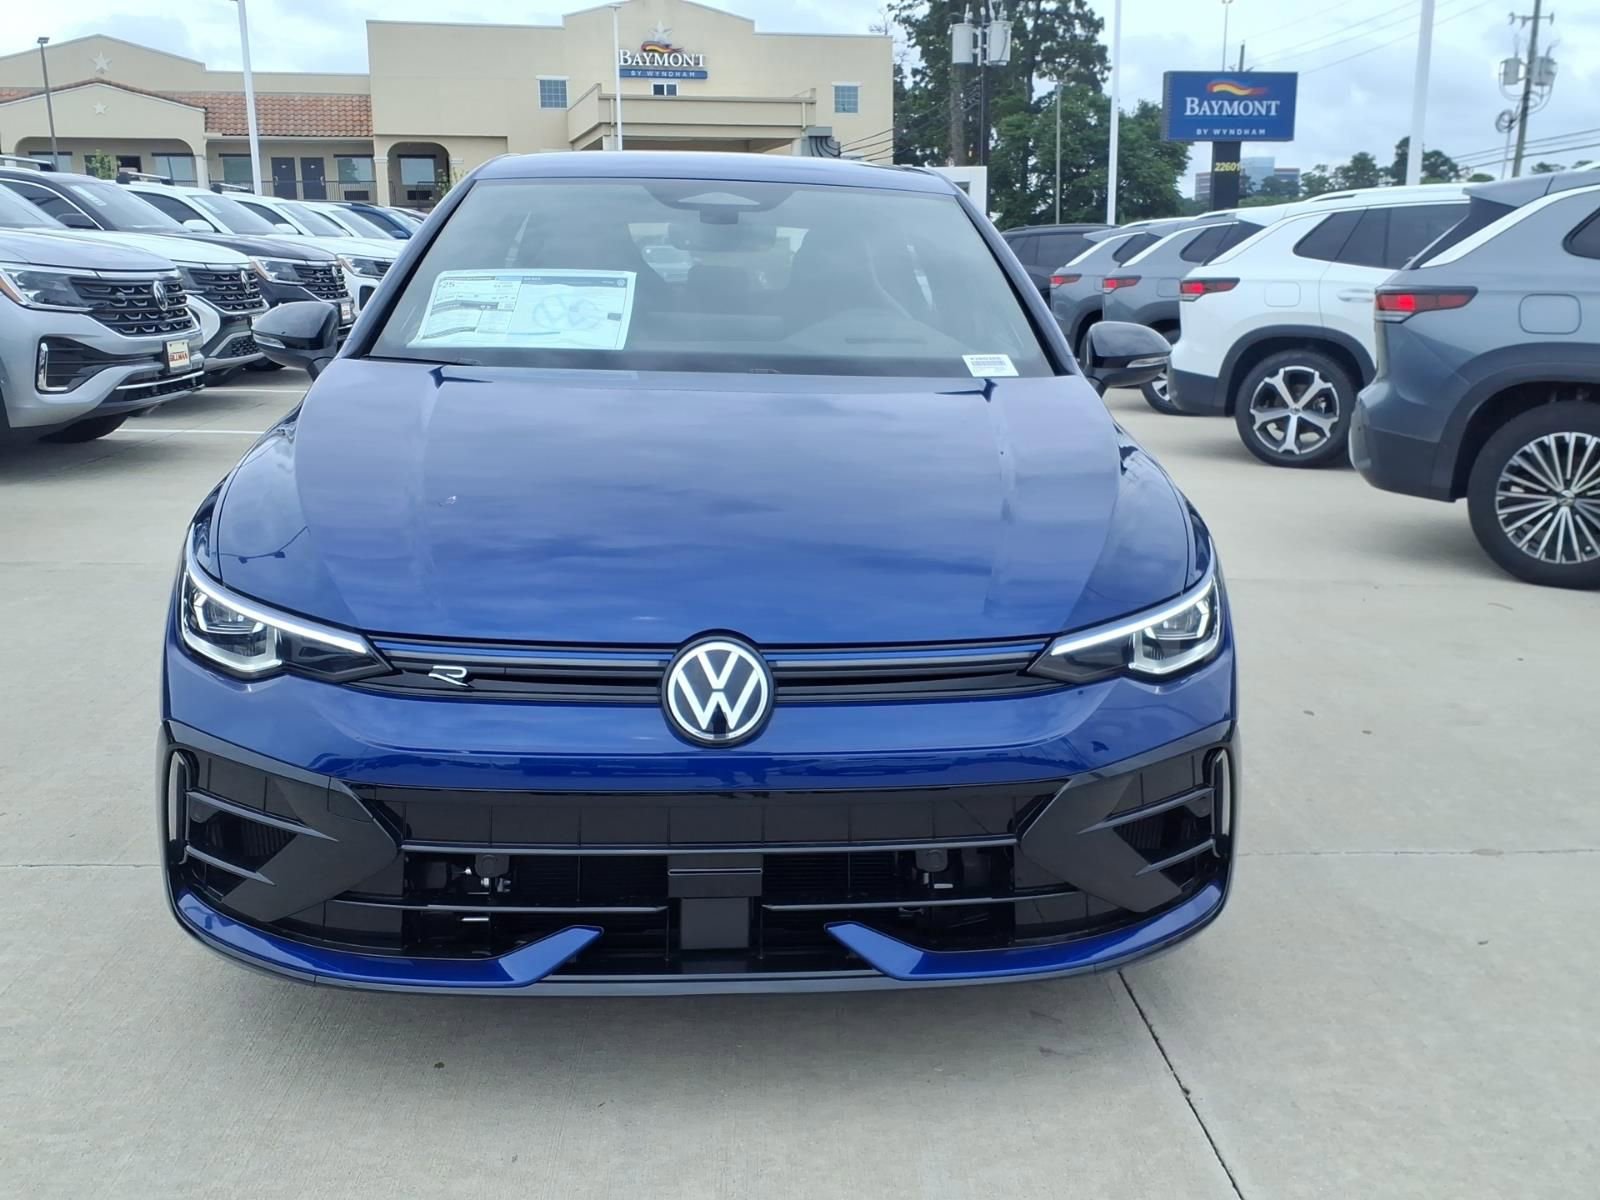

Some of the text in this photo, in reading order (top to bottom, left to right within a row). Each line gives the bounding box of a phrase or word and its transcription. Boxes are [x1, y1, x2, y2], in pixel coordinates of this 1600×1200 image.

[619, 49, 704, 67] BAYMONT
[1184, 97, 1280, 116] BAYMONT
[1214, 162, 1240, 172] 22601
